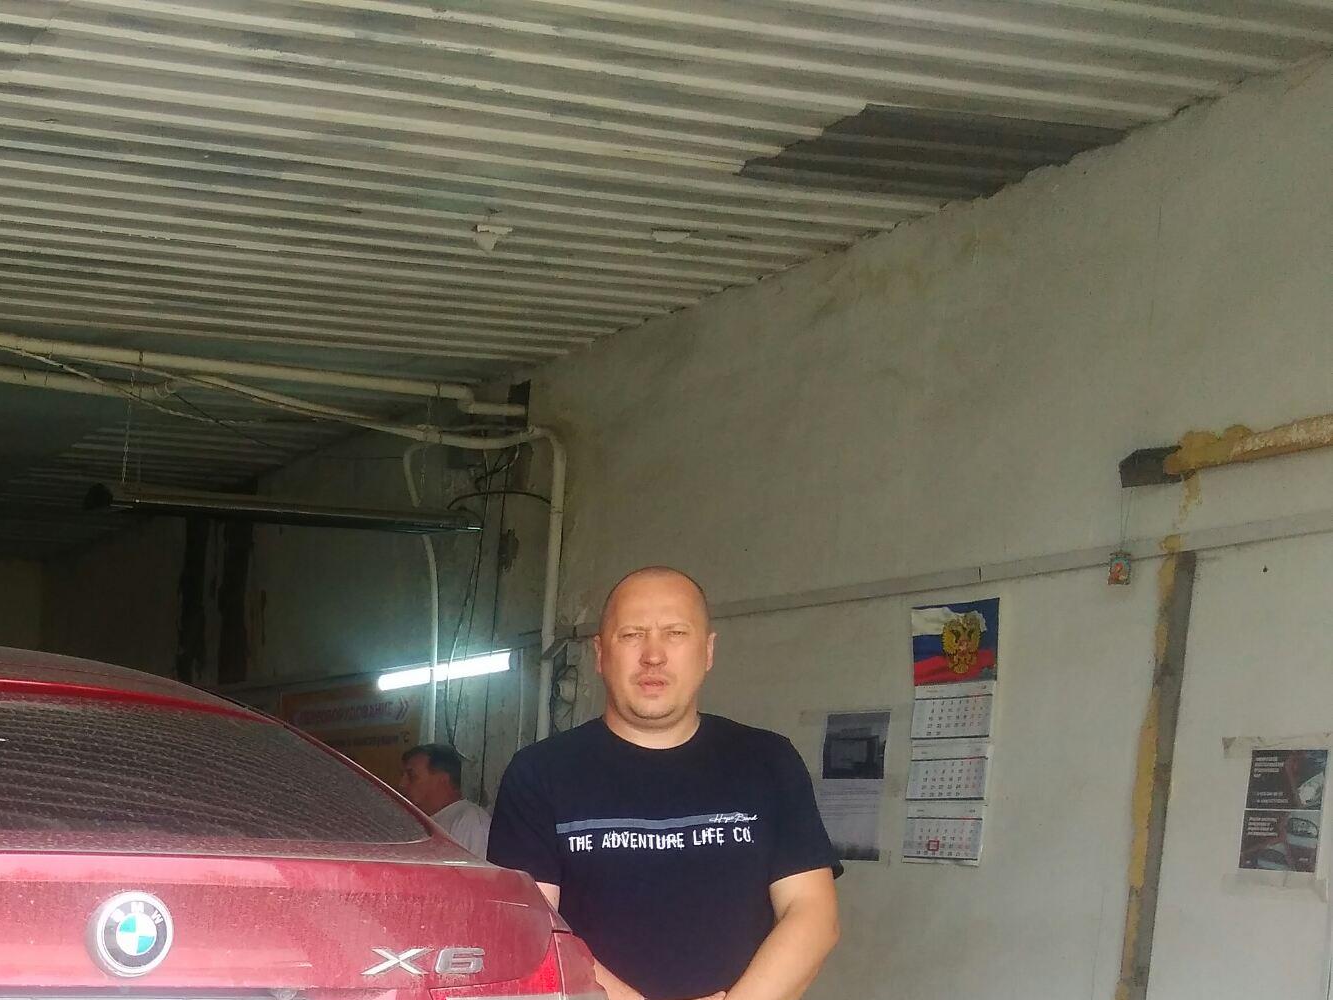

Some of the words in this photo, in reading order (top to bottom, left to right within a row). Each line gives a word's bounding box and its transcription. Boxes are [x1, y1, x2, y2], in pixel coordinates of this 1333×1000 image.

[568, 834, 593, 853] THE
[602, 830, 685, 851] ADVENTURE
[693, 827, 725, 847] LIFE
[360, 947, 485, 975] X6
